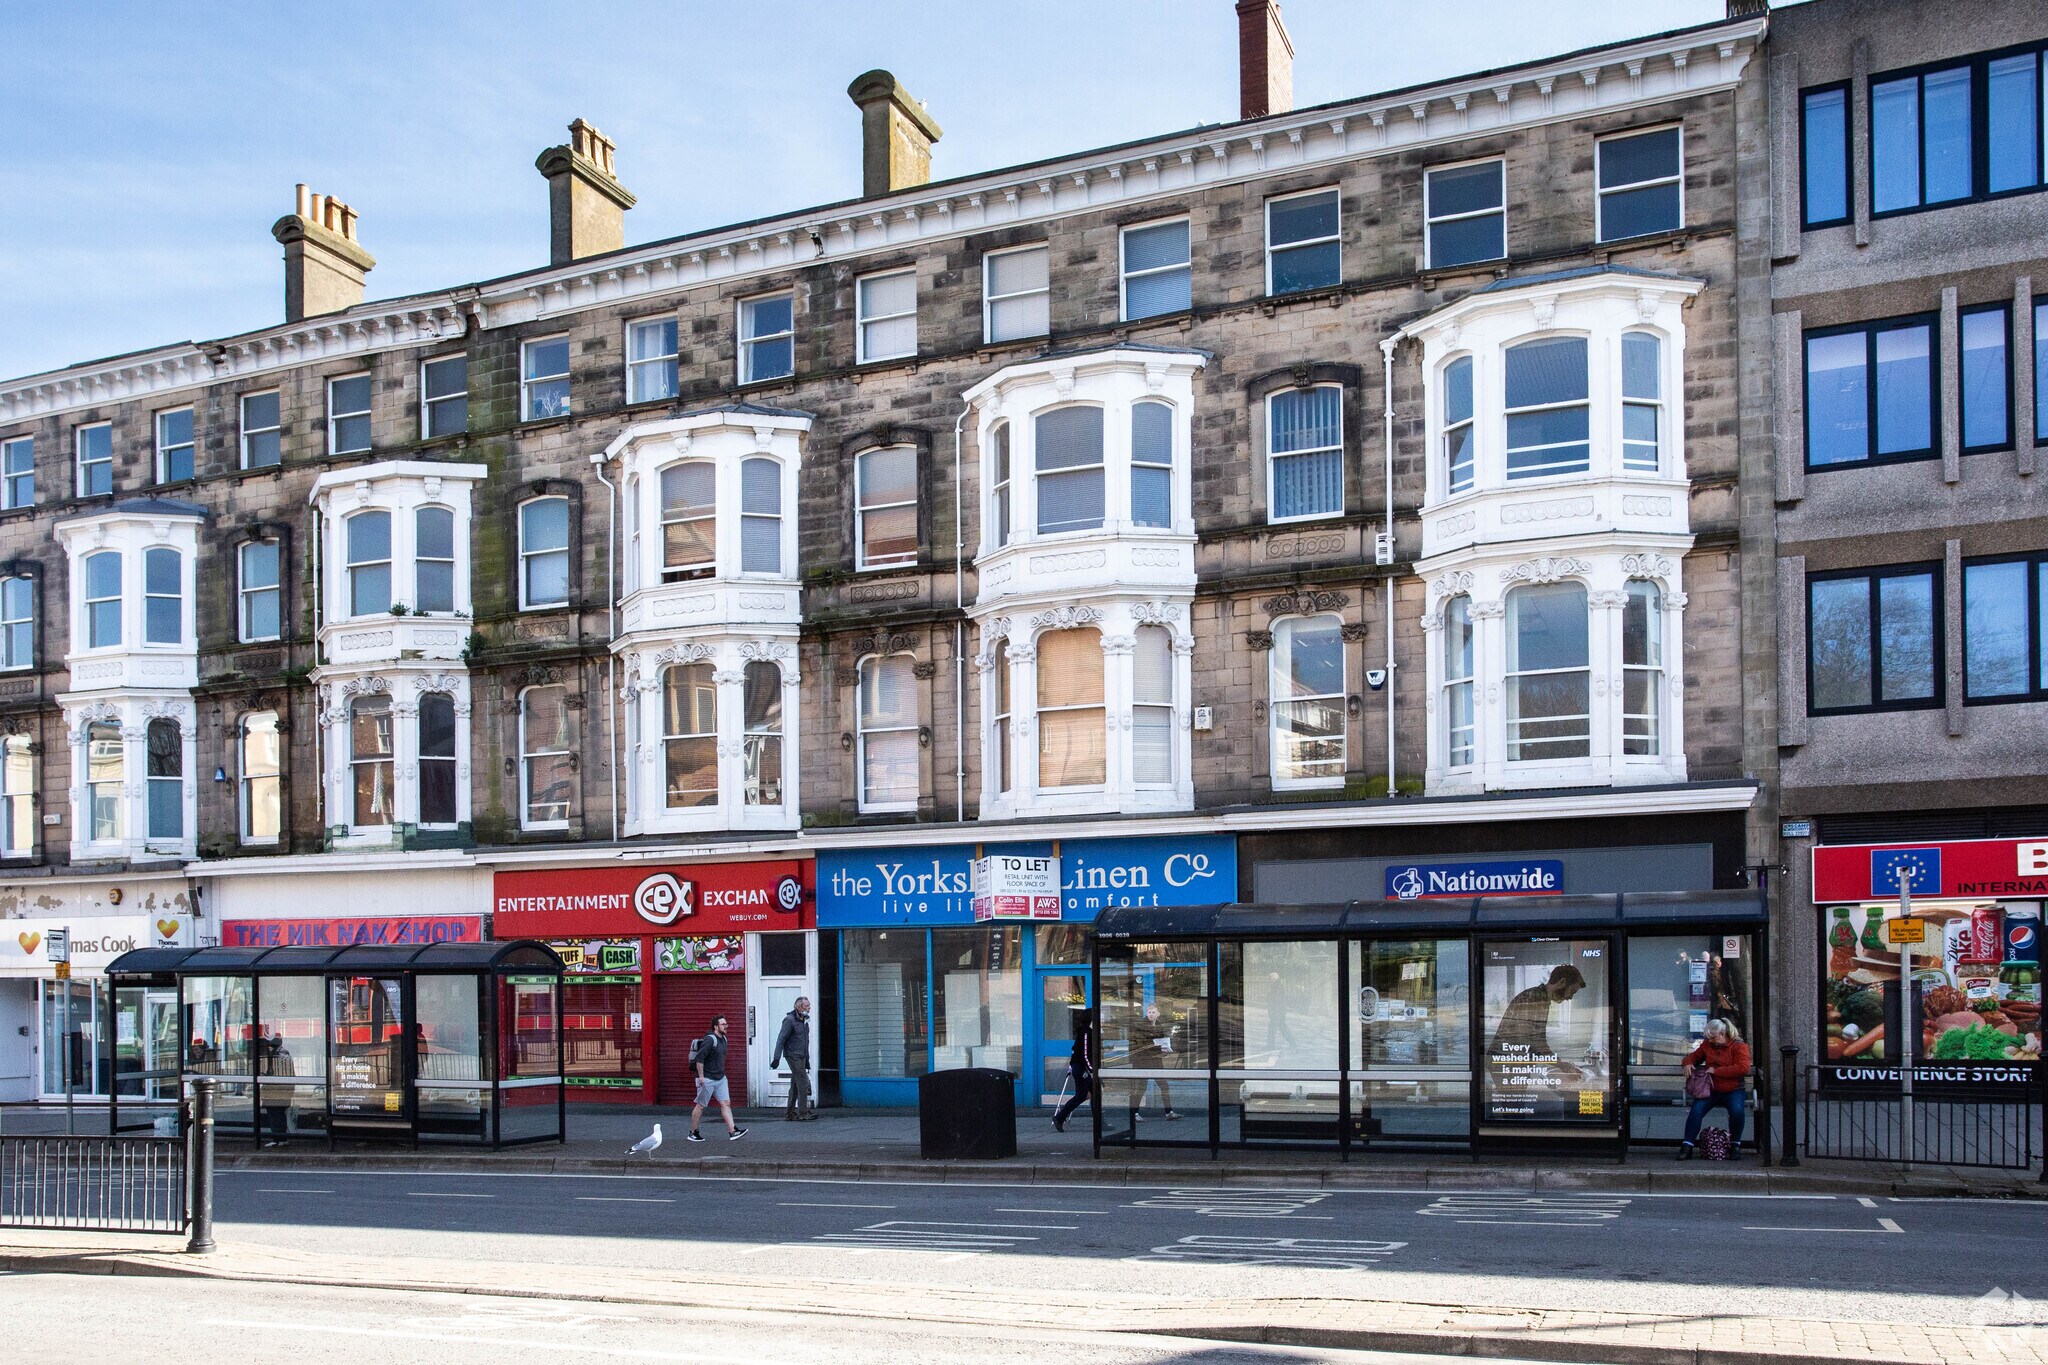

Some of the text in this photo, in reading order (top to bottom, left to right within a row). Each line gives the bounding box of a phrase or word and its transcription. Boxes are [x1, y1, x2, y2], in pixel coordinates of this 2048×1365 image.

[1001, 858, 1050, 872] TO LET
[832, 868, 872, 897] the
[1428, 867, 1555, 892] Nationwide
[1958, 880, 2048, 894] INTERNA
[498, 889, 769, 913] ENTERTAINMENT EXCHAN
[883, 900, 928, 914] live
[946, 898, 975, 912] lif
[1068, 892, 1159, 909] omfort
[1036, 898, 1057, 908] AWS
[729, 913, 768, 922] WEBUY.COM
[234, 921, 465, 946] THE NIK NAK SHOP
[44, 935, 136, 953] mas Cook
[1947, 937, 1958, 963] Diet
[559, 950, 633, 964] TUFF for CASH
[1582, 949, 1601, 957] NHS
[2008, 948, 2017, 961] psi
[1502, 1043, 1531, 1053] Every
[341, 1056, 358, 1064] Every
[1492, 1053, 1558, 1061] washed hand
[336, 1064, 345, 1072] day
[1502, 1065, 1548, 1076] is making
[1836, 1067, 1967, 1081] CONVEIENCE
[347, 1073, 369, 1081] making
[1510, 1076, 1562, 1085] difference
[346, 1081, 376, 1089] difference
